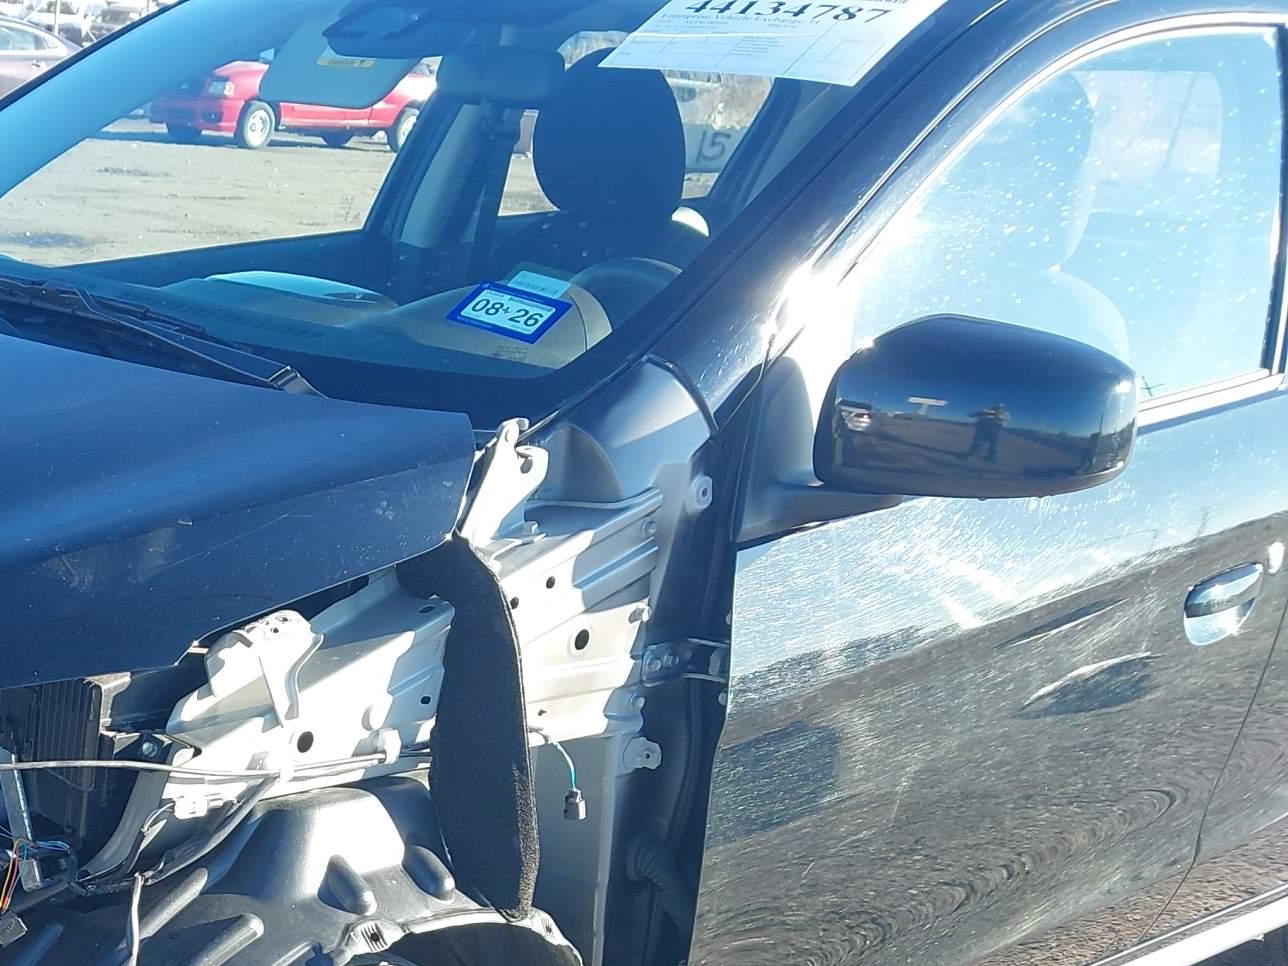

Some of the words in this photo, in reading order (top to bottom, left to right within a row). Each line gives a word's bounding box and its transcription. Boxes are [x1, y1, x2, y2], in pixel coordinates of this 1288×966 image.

[685, 0, 892, 23] 44134787
[471, 298, 505, 316] 08
[507, 308, 544, 327] 26
